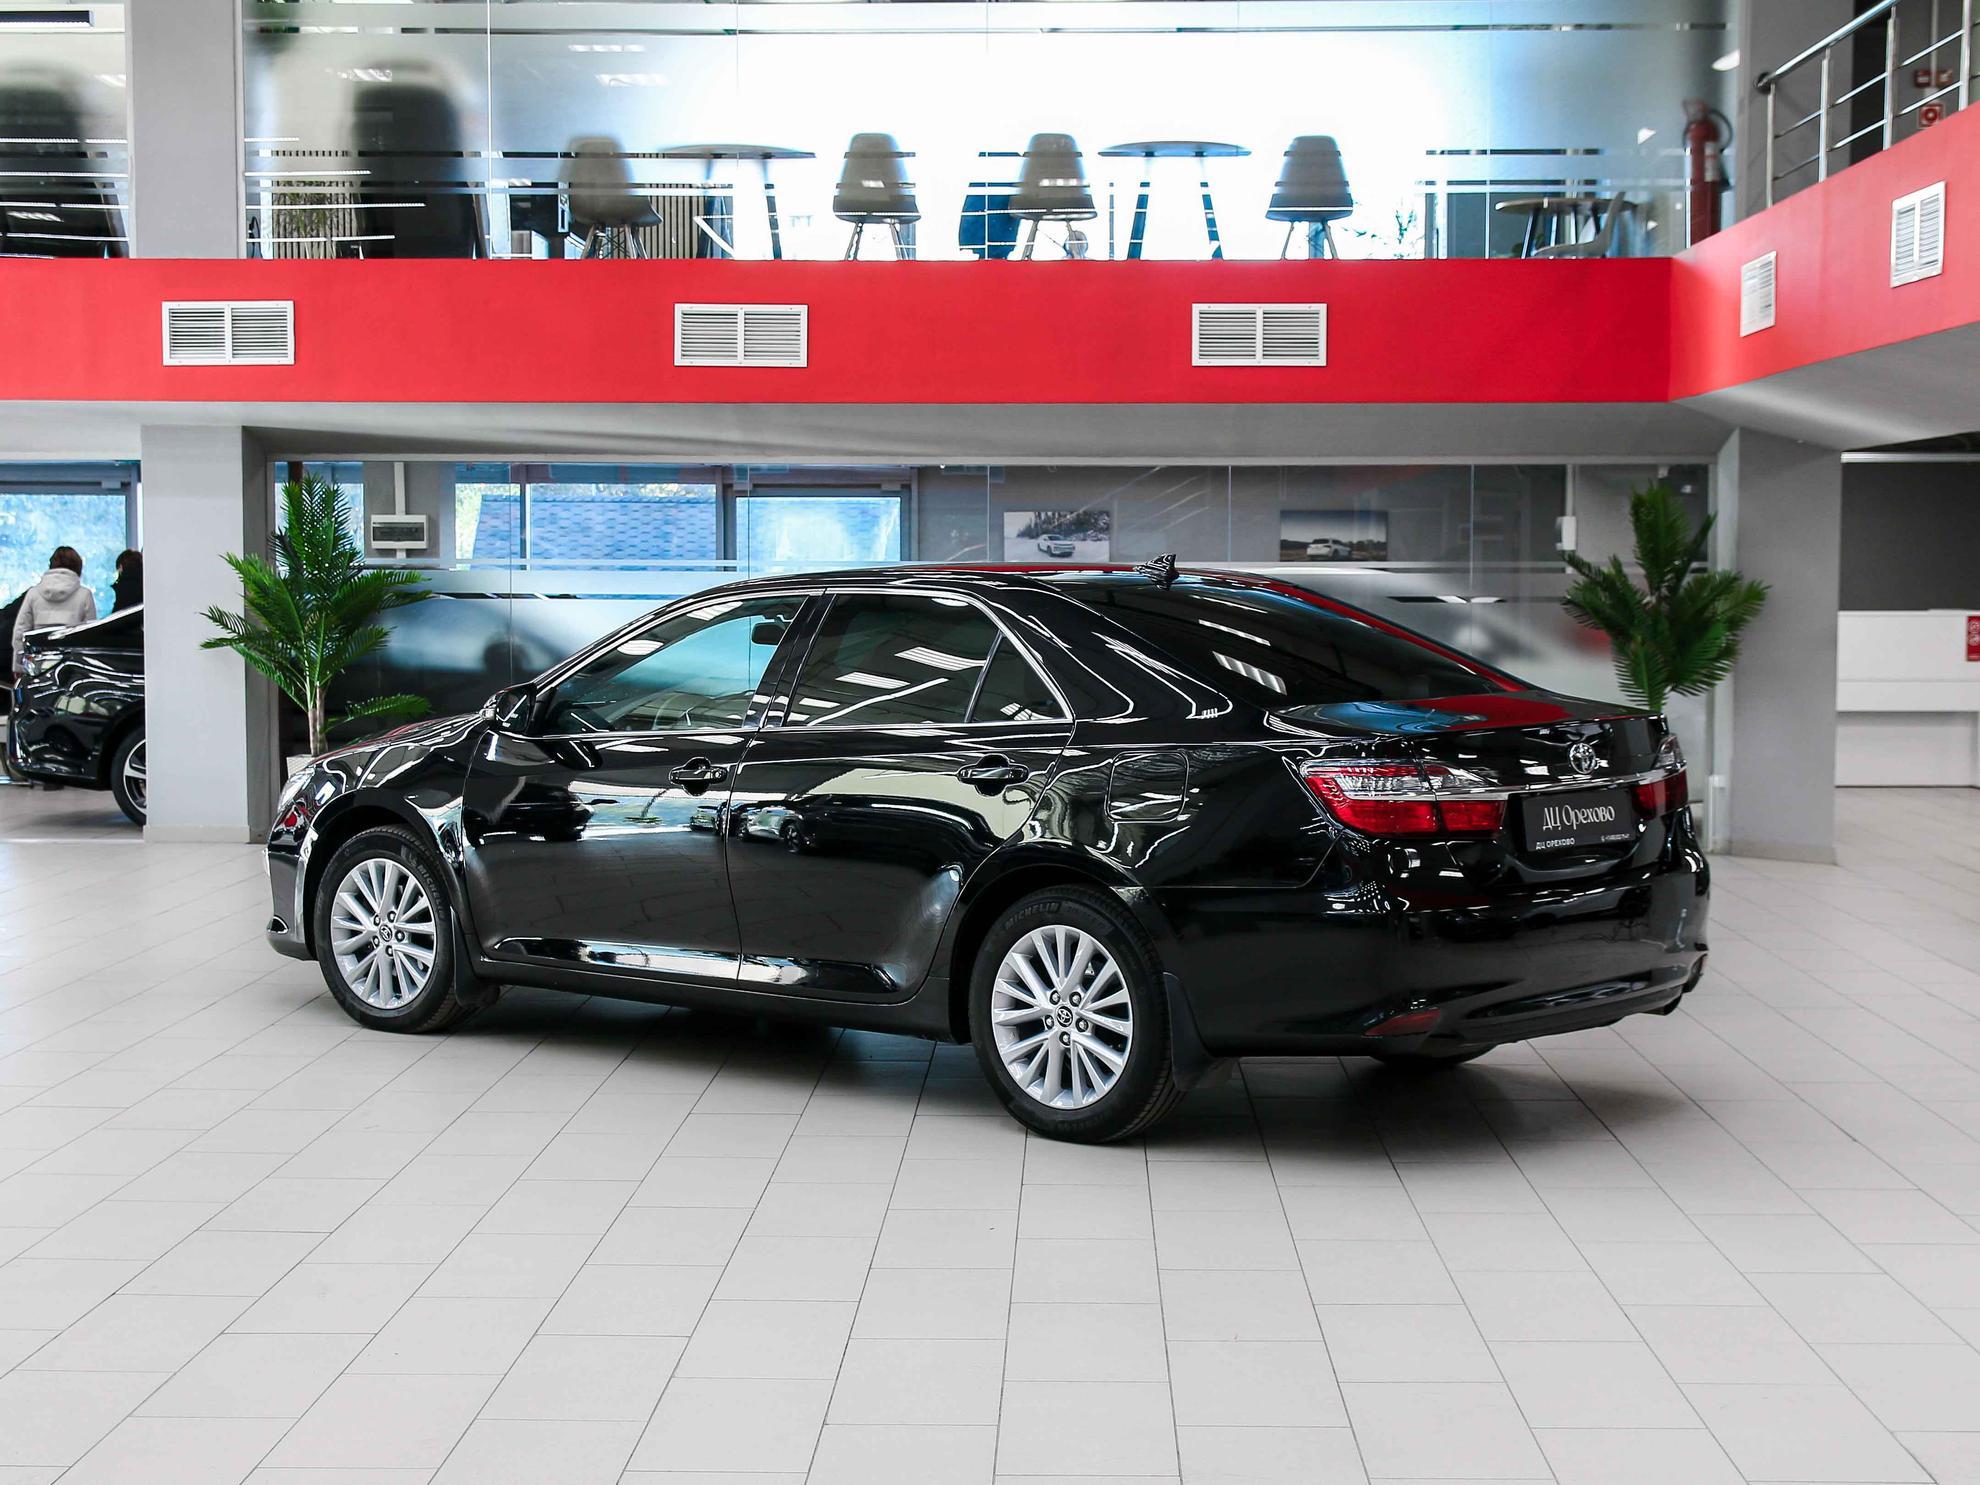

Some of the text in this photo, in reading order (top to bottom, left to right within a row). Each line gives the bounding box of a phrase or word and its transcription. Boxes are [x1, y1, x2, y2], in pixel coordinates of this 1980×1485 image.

[1543, 804, 1615, 831] ДЦ Орехово
[1536, 838, 1575, 850] ДЦ ОРЕХОВО
[1005, 902, 1061, 930] MICHELIN
